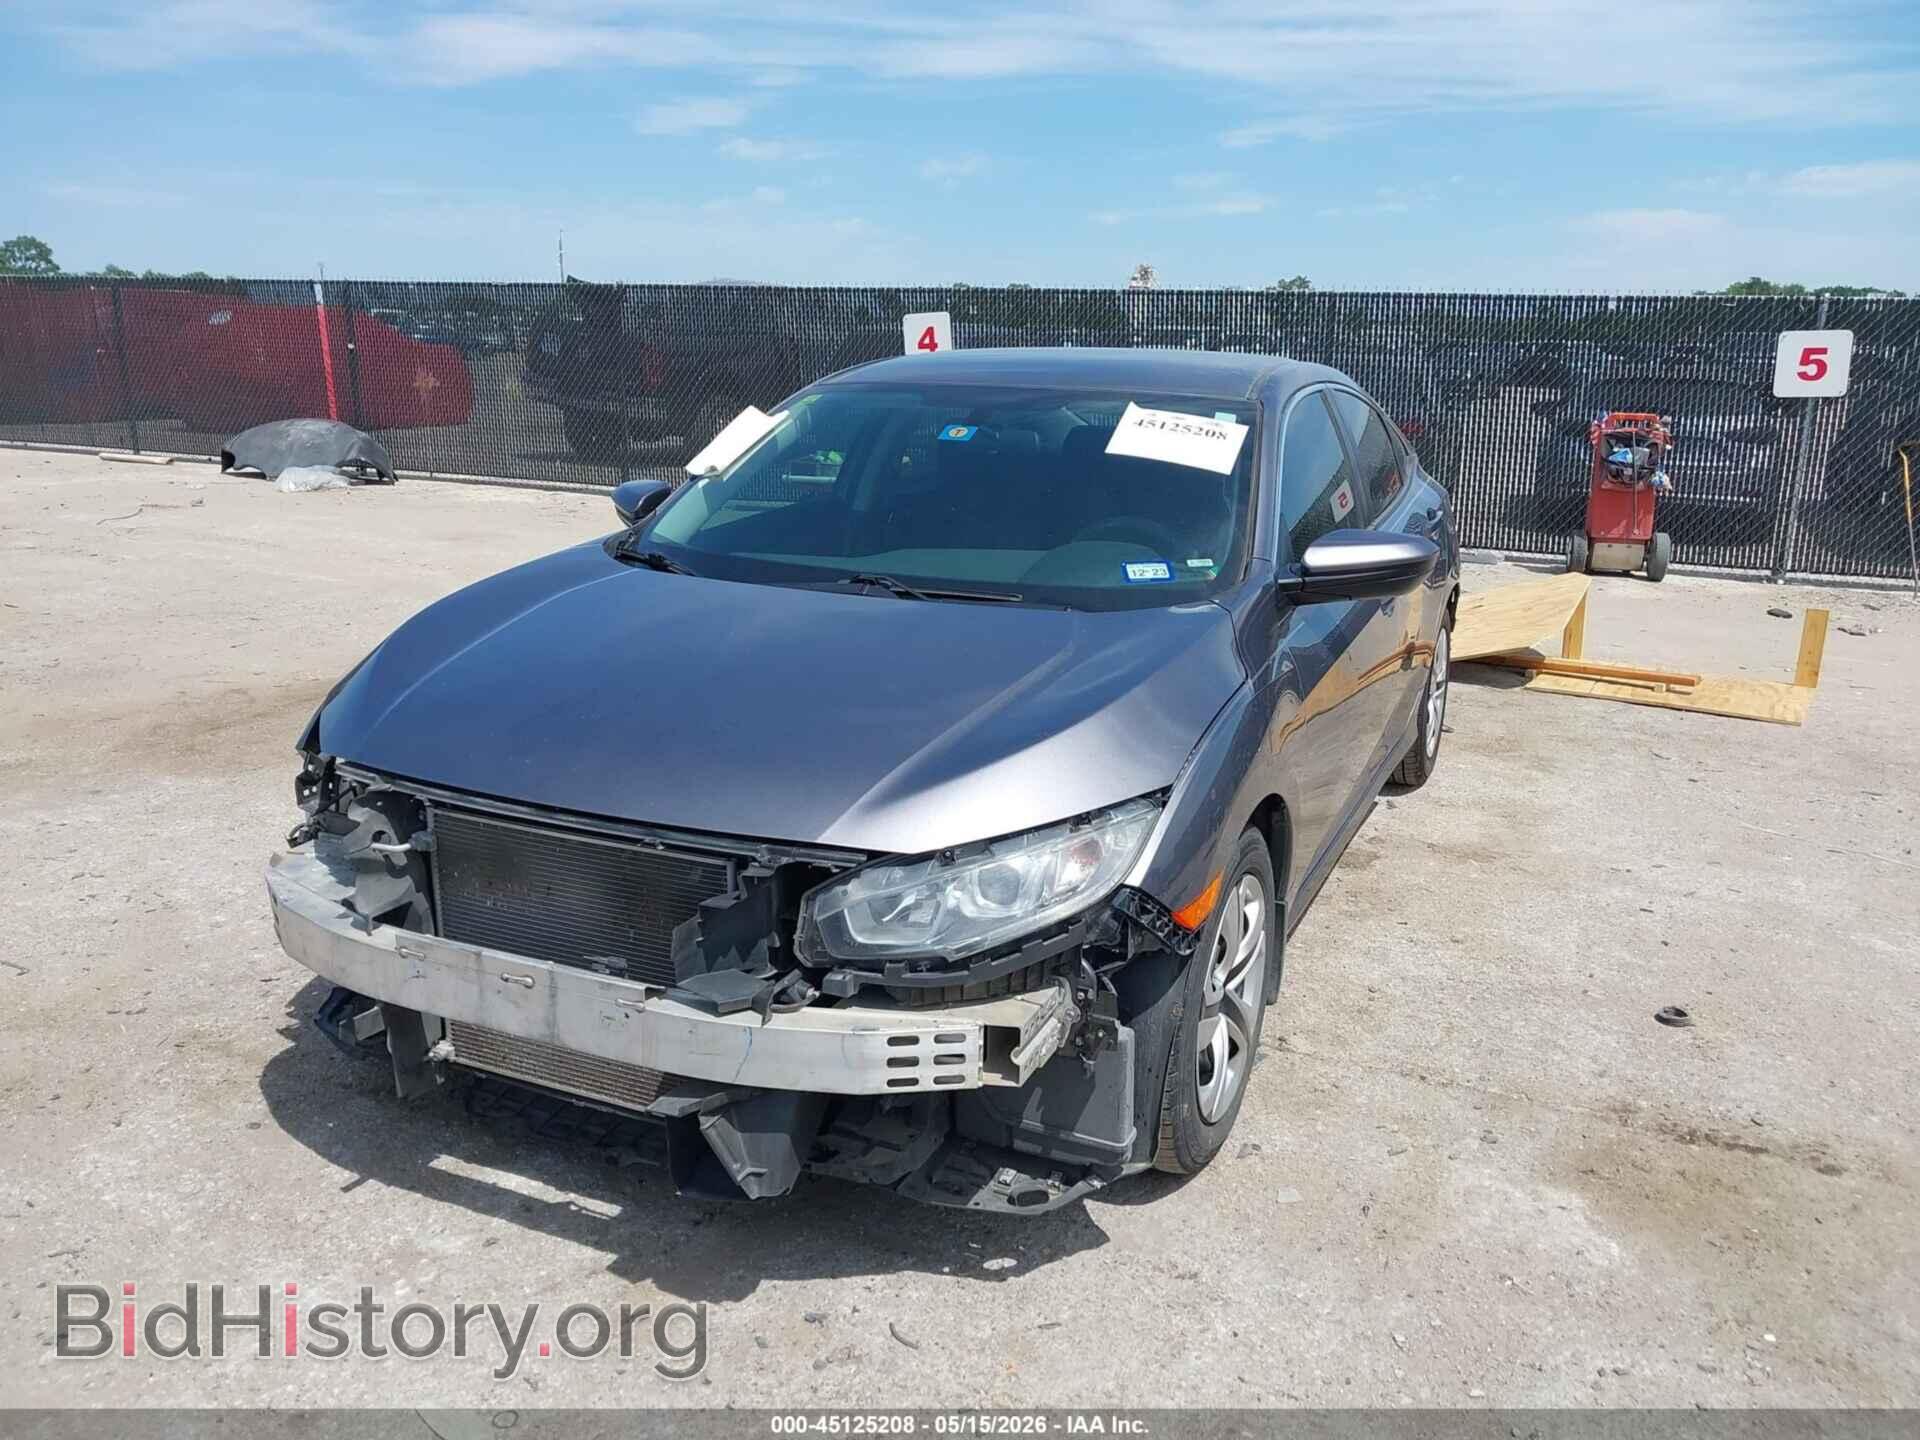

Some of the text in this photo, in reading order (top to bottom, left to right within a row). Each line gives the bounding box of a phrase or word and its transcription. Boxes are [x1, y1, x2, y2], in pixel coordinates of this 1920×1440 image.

[917, 326, 938, 352] 4
[1796, 347, 1828, 381] 5
[1133, 418, 1229, 440] 45125208
